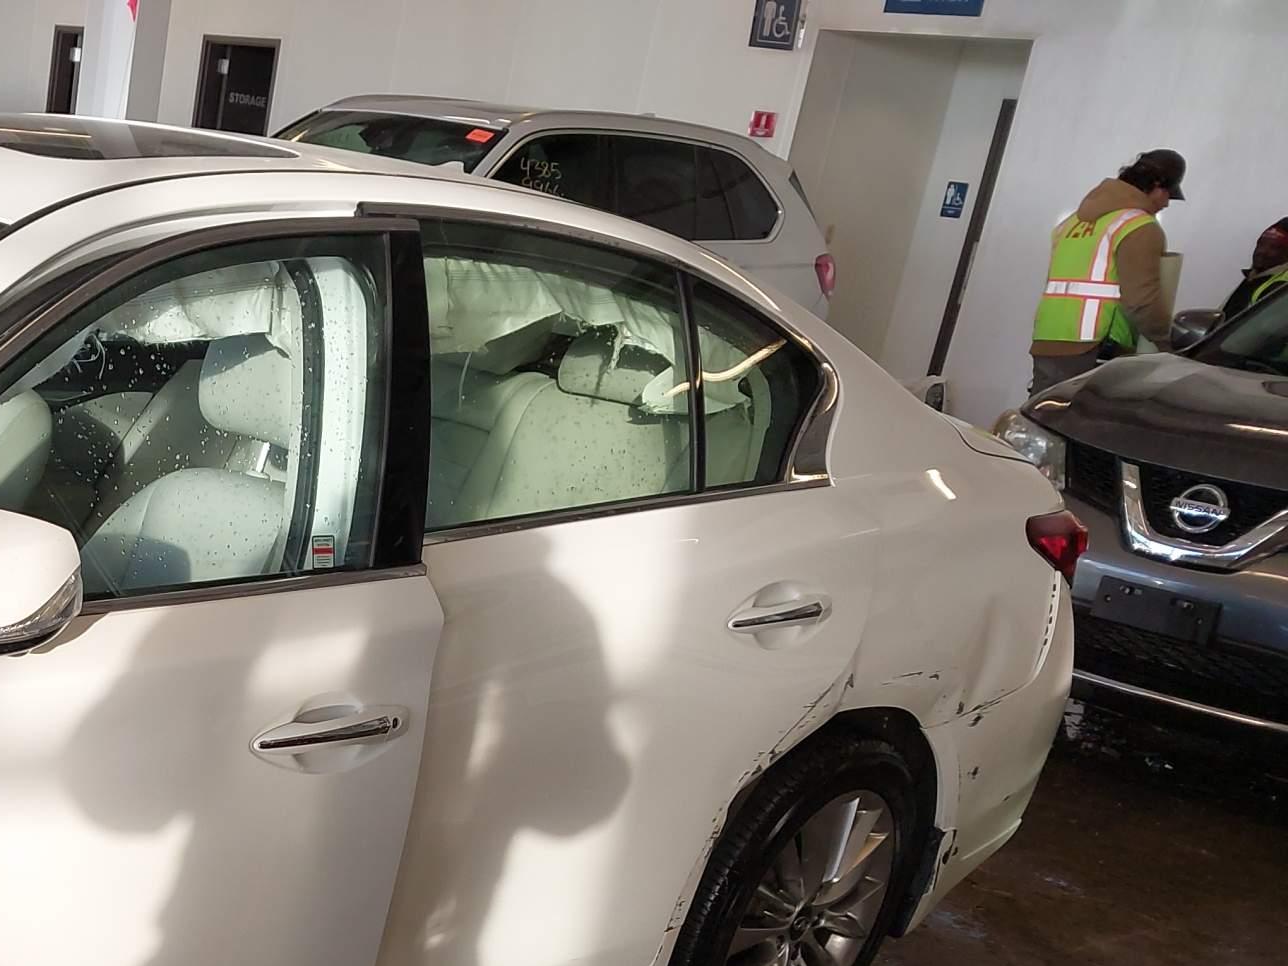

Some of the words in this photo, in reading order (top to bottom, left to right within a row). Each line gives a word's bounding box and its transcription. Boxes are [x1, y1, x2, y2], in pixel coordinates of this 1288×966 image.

[228, 91, 268, 108] STORAGE
[520, 157, 562, 179] 4385
[1175, 502, 1225, 516] NISSAN
